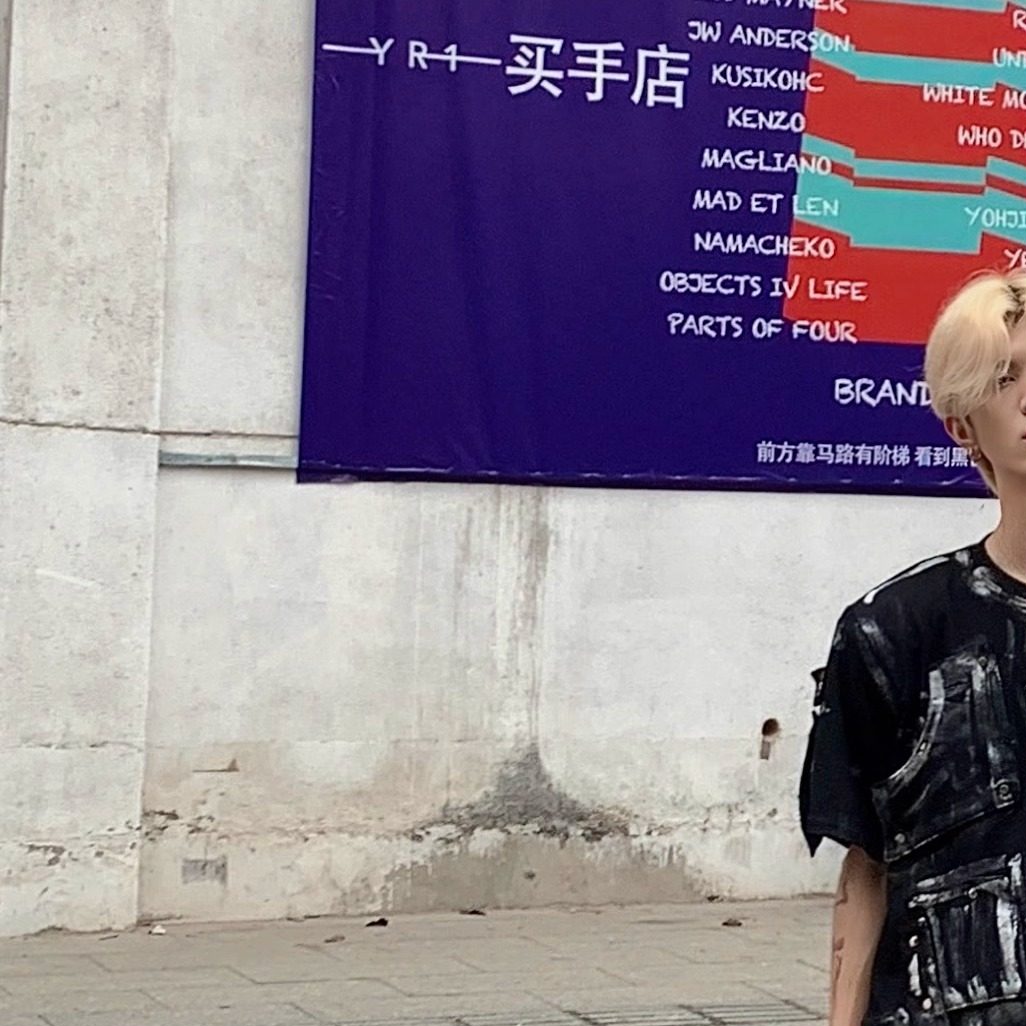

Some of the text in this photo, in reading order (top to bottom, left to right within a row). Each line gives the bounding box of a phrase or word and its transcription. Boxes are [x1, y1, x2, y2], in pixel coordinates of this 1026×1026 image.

[688, 20, 850, 52] JW ANDERSON
[505, 33, 691, 109] 买手店
[711, 63, 824, 92] KUSIKOHC
[922, 82, 994, 107] WHITE
[727, 107, 806, 132] KENZO
[958, 125, 1001, 148] WHO
[701, 148, 832, 176] MAGLIANO
[692, 189, 839, 217] MAD ET LEN
[694, 232, 836, 259] NAMACHEKO
[659, 271, 868, 301] OBJECTS IV LIFE
[667, 313, 858, 344] PARTS OF FOUR
[757, 441, 977, 467] 前方靠马路有阶梯 看到黑
